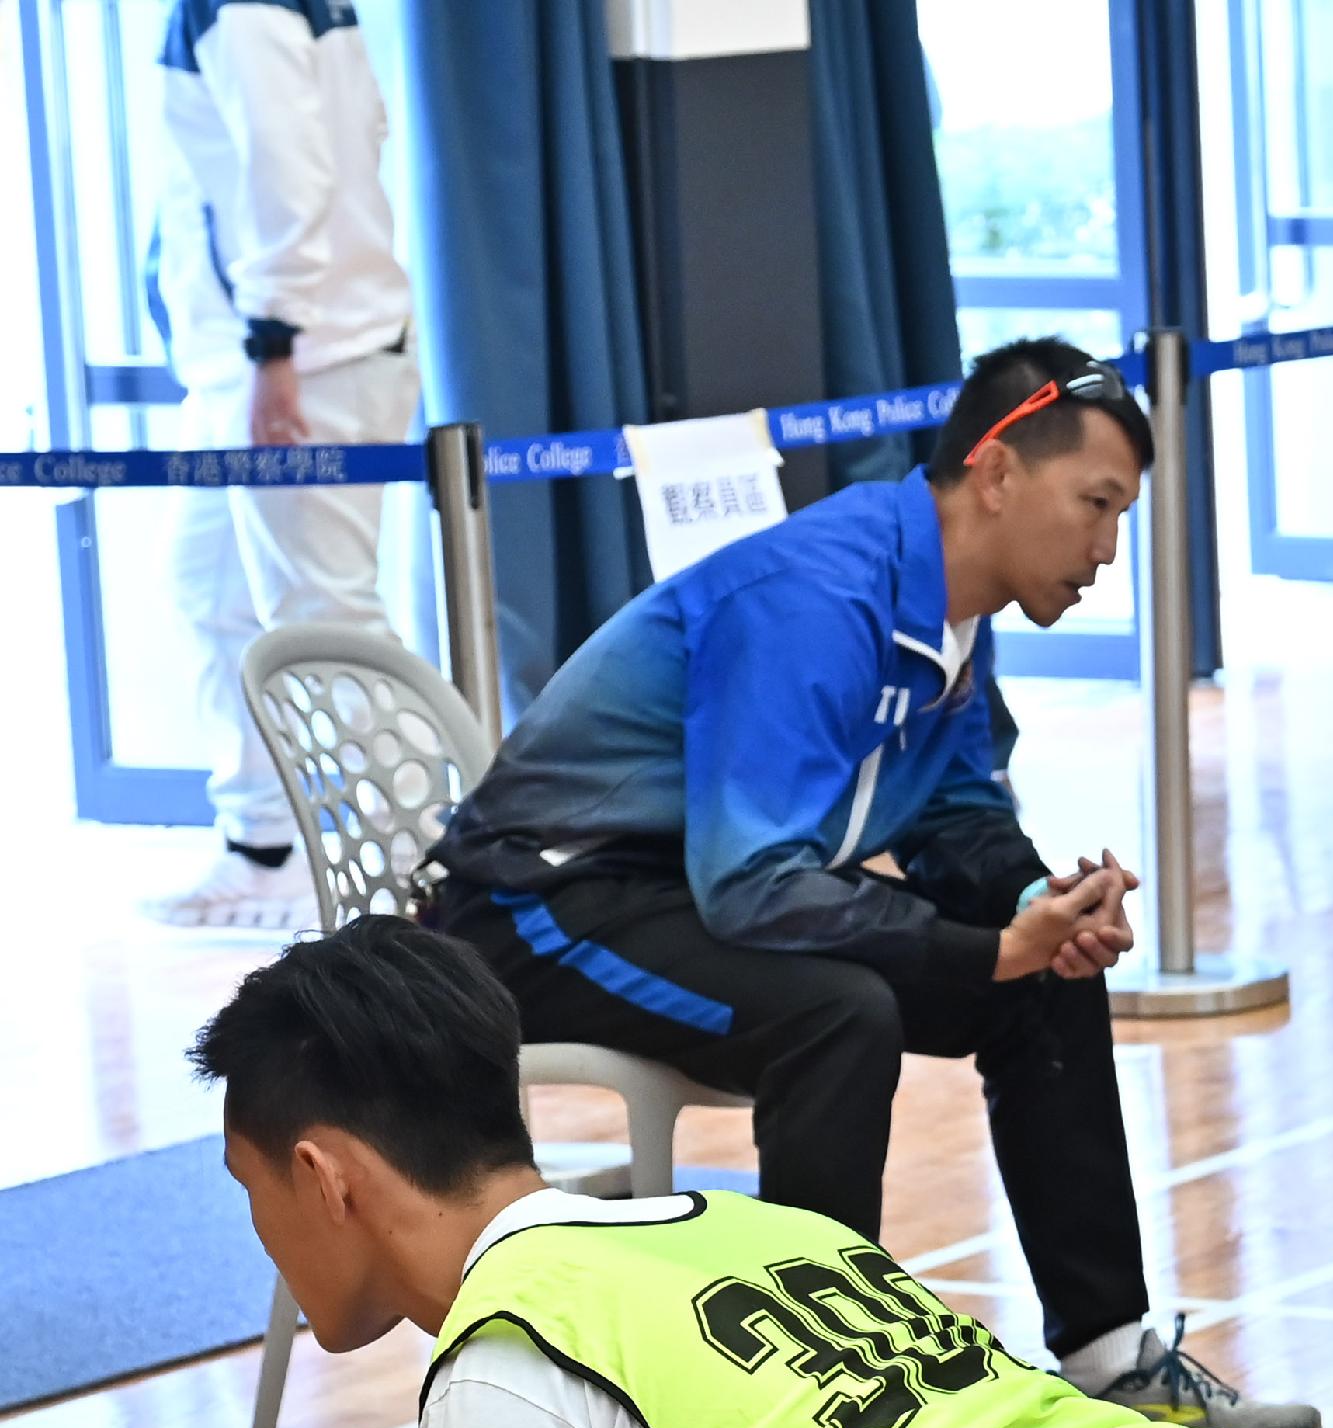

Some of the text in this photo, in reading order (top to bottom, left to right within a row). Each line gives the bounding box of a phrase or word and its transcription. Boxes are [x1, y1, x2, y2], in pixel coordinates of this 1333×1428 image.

[780, 412, 826, 444] Hong
[828, 405, 874, 437] Kong
[876, 395, 925, 427] Police
[33, 453, 127, 487] College
[526, 441, 592, 476] College
